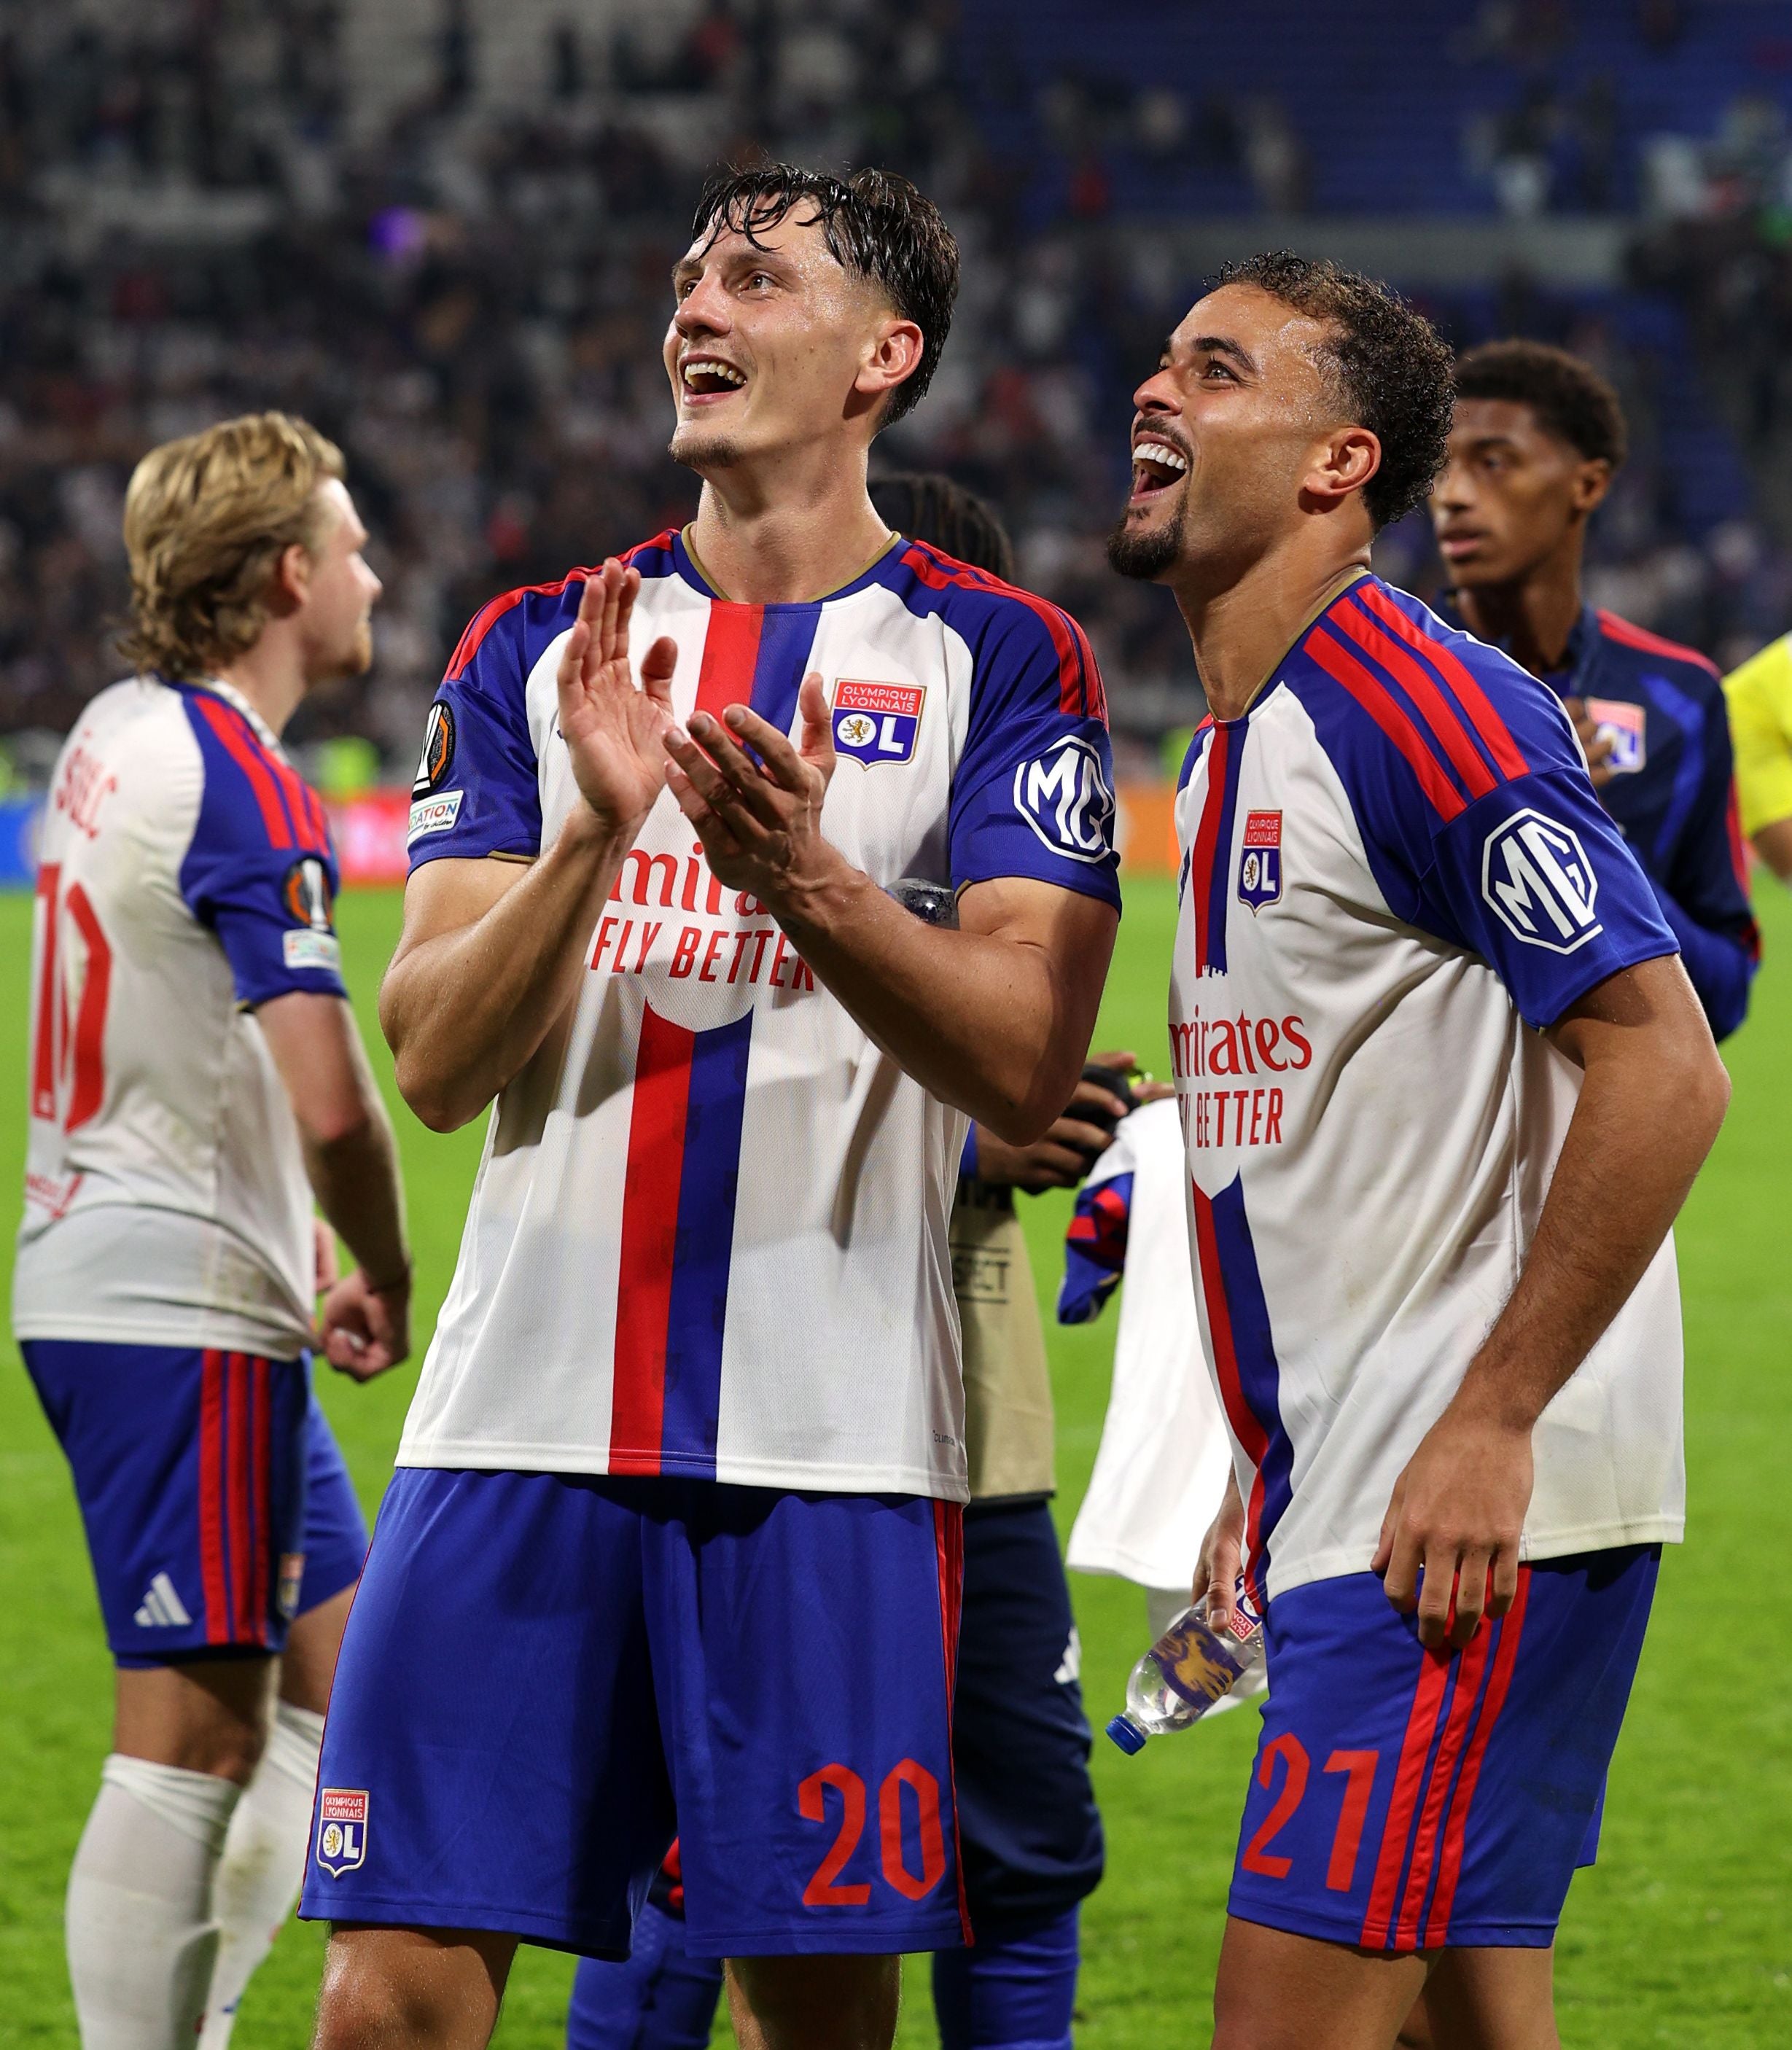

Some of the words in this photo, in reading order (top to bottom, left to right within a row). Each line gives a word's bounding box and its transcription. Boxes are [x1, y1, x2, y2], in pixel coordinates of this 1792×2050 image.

[841, 695, 915, 712] LYONNAIS
[843, 685, 917, 702] OLYMPIQUE
[836, 713, 905, 754] OL
[408, 803, 458, 830] DATION
[1026, 746, 1110, 851] MG
[1247, 831, 1278, 843] LYONNAIS
[1249, 819, 1279, 830] OLYMPIQUE
[1243, 851, 1276, 892] OL
[1495, 819, 1597, 940] MG
[591, 916, 663, 975] FLY
[31, 862, 114, 1136] 10
[1196, 1088, 1284, 1148] BETTER
[325, 1796, 363, 1807] OLYMPIQUE
[325, 1807, 363, 1818] LYONNAIS
[1241, 1731, 1380, 1893] 21
[323, 1823, 359, 1859] OL
[798, 1758, 946, 1906] 20
